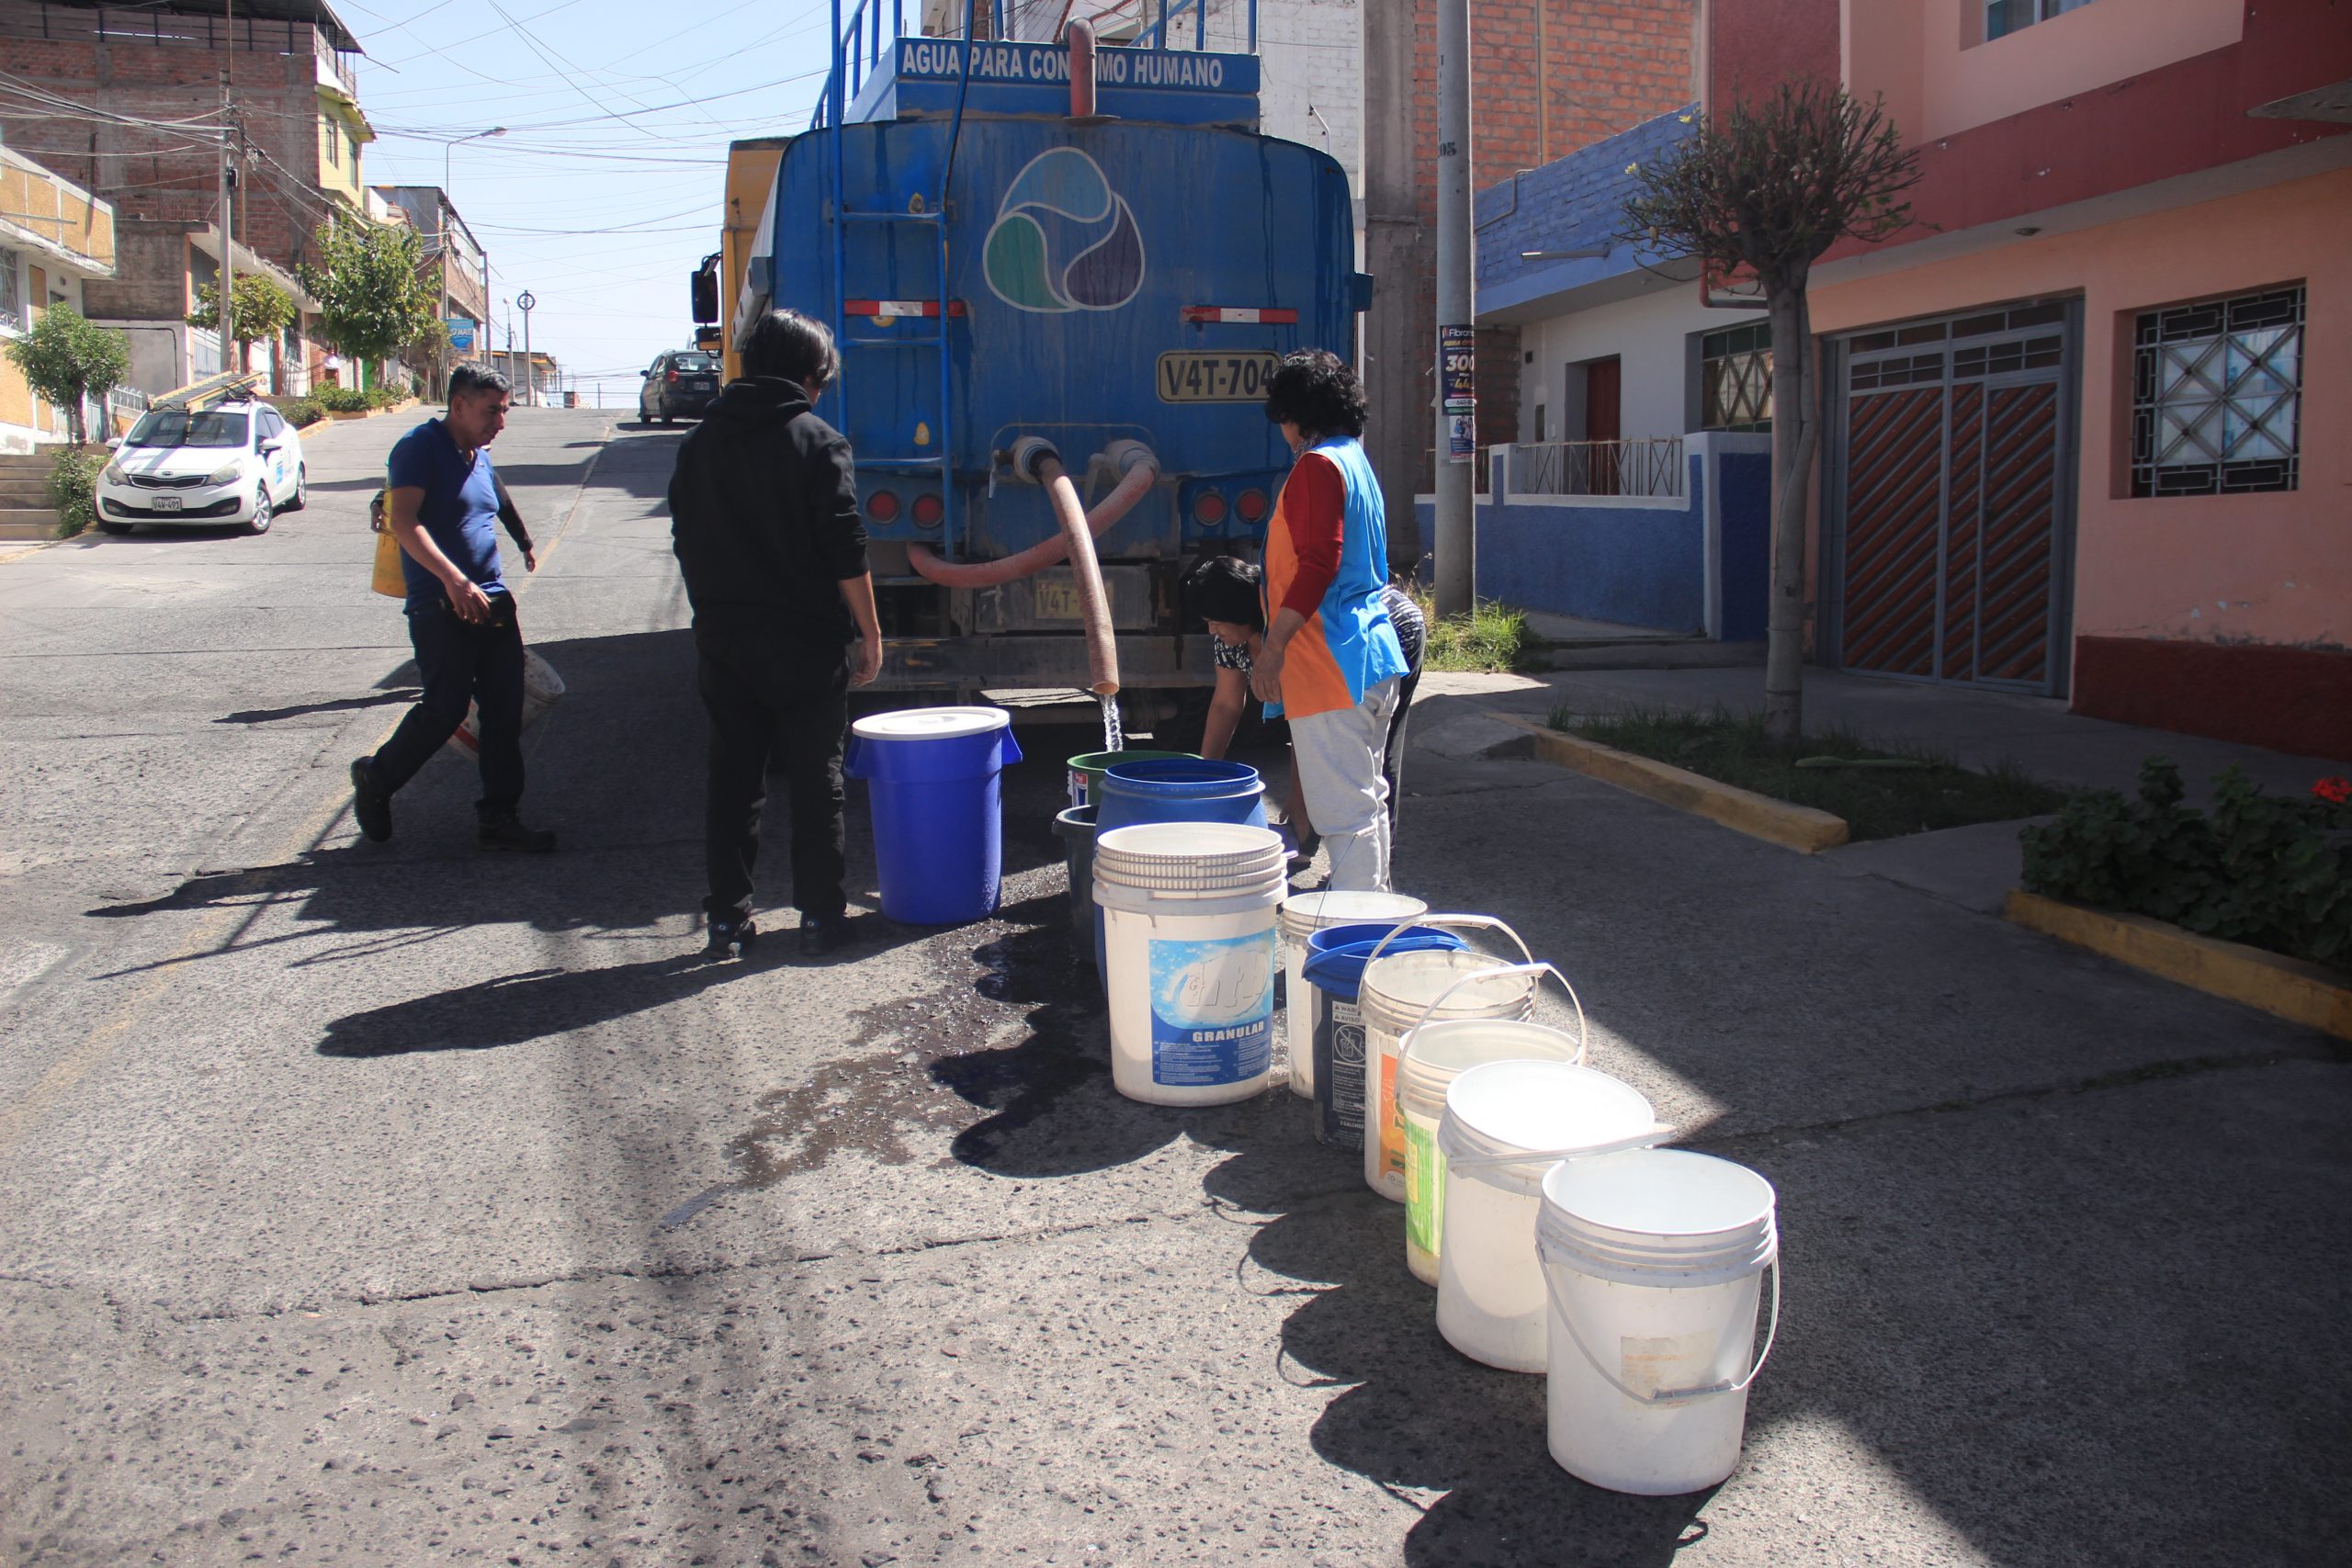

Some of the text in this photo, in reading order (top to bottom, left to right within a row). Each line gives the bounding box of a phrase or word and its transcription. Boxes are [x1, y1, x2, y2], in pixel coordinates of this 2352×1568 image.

[902, 43, 1223, 88] AGUA PARA CONMO HUMANO
[1165, 359, 1274, 396] V4T-704
[1193, 1021, 1264, 1043] GRANULAR
[1340, 1015, 1360, 1023] AVISO
